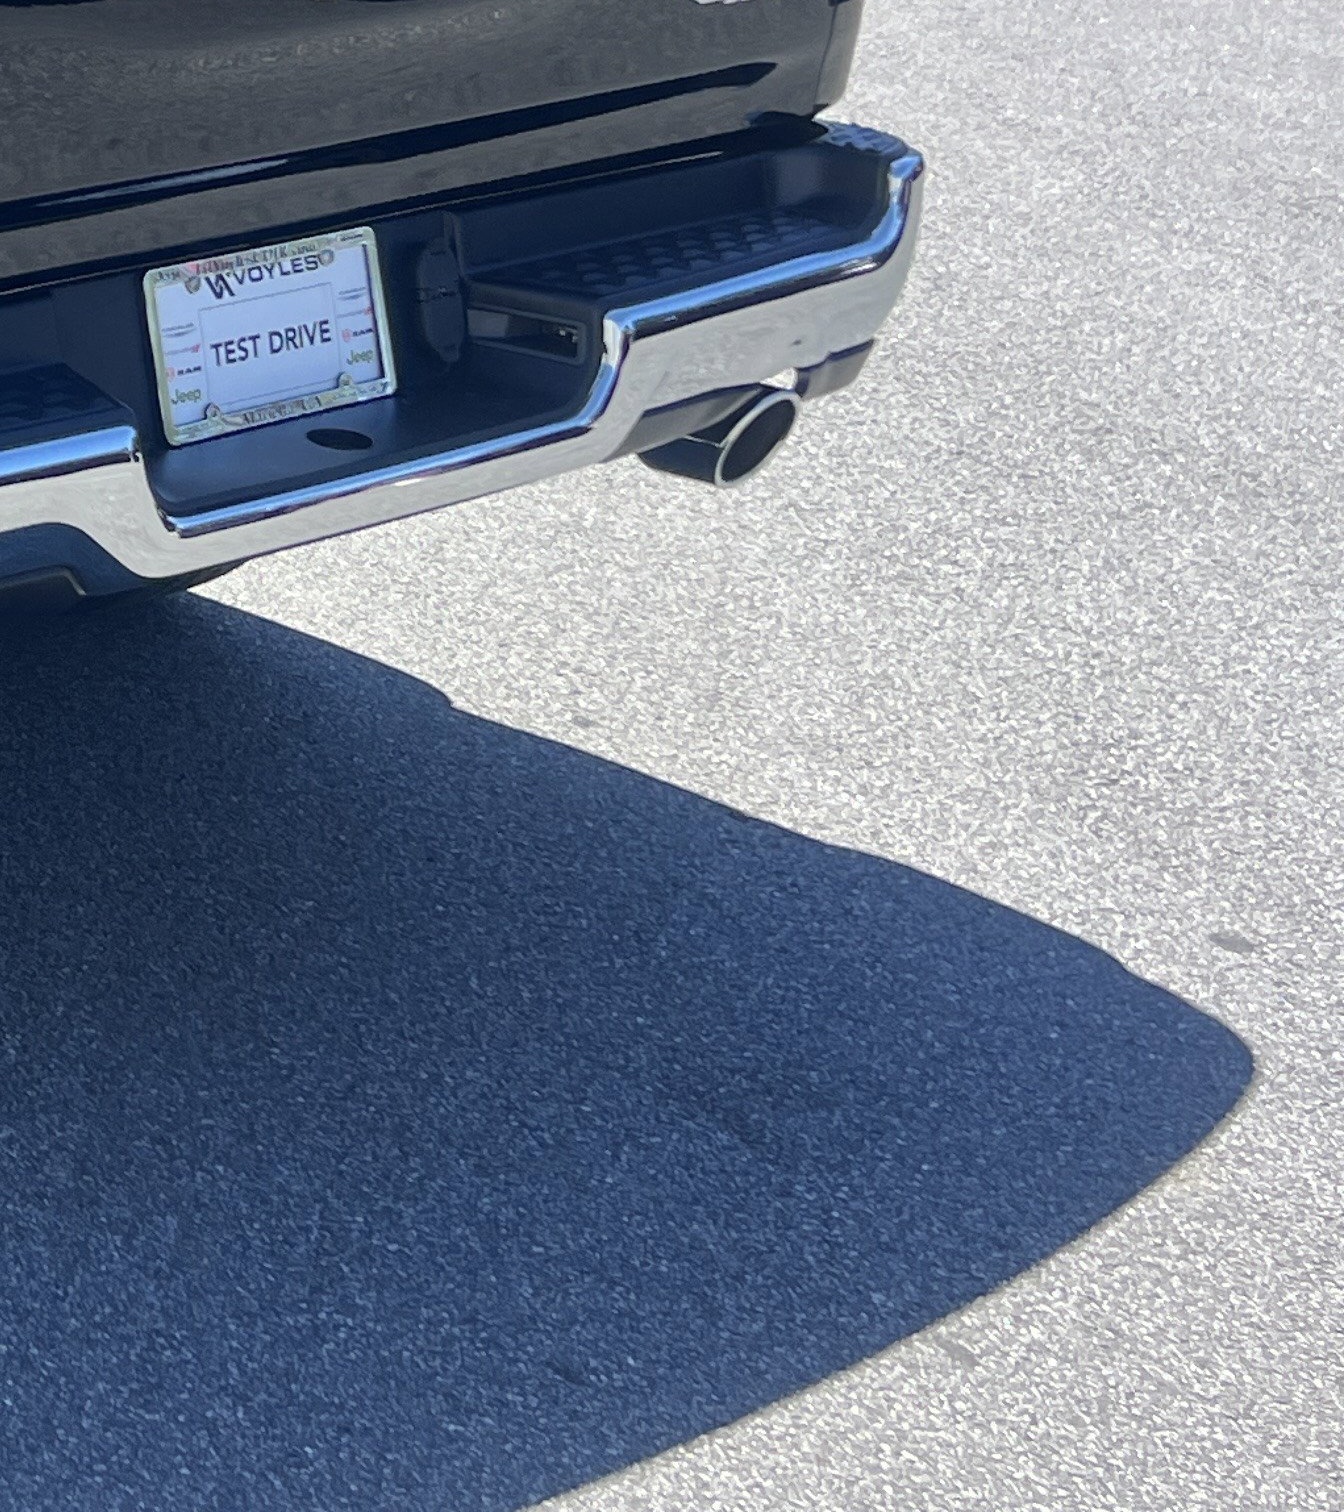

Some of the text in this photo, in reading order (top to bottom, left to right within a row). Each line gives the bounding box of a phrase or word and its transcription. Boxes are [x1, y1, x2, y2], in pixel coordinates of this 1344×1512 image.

[231, 255, 318, 285] VOYLES
[211, 320, 332, 366] TEST DRIVE
[171, 389, 202, 405] Jeep
